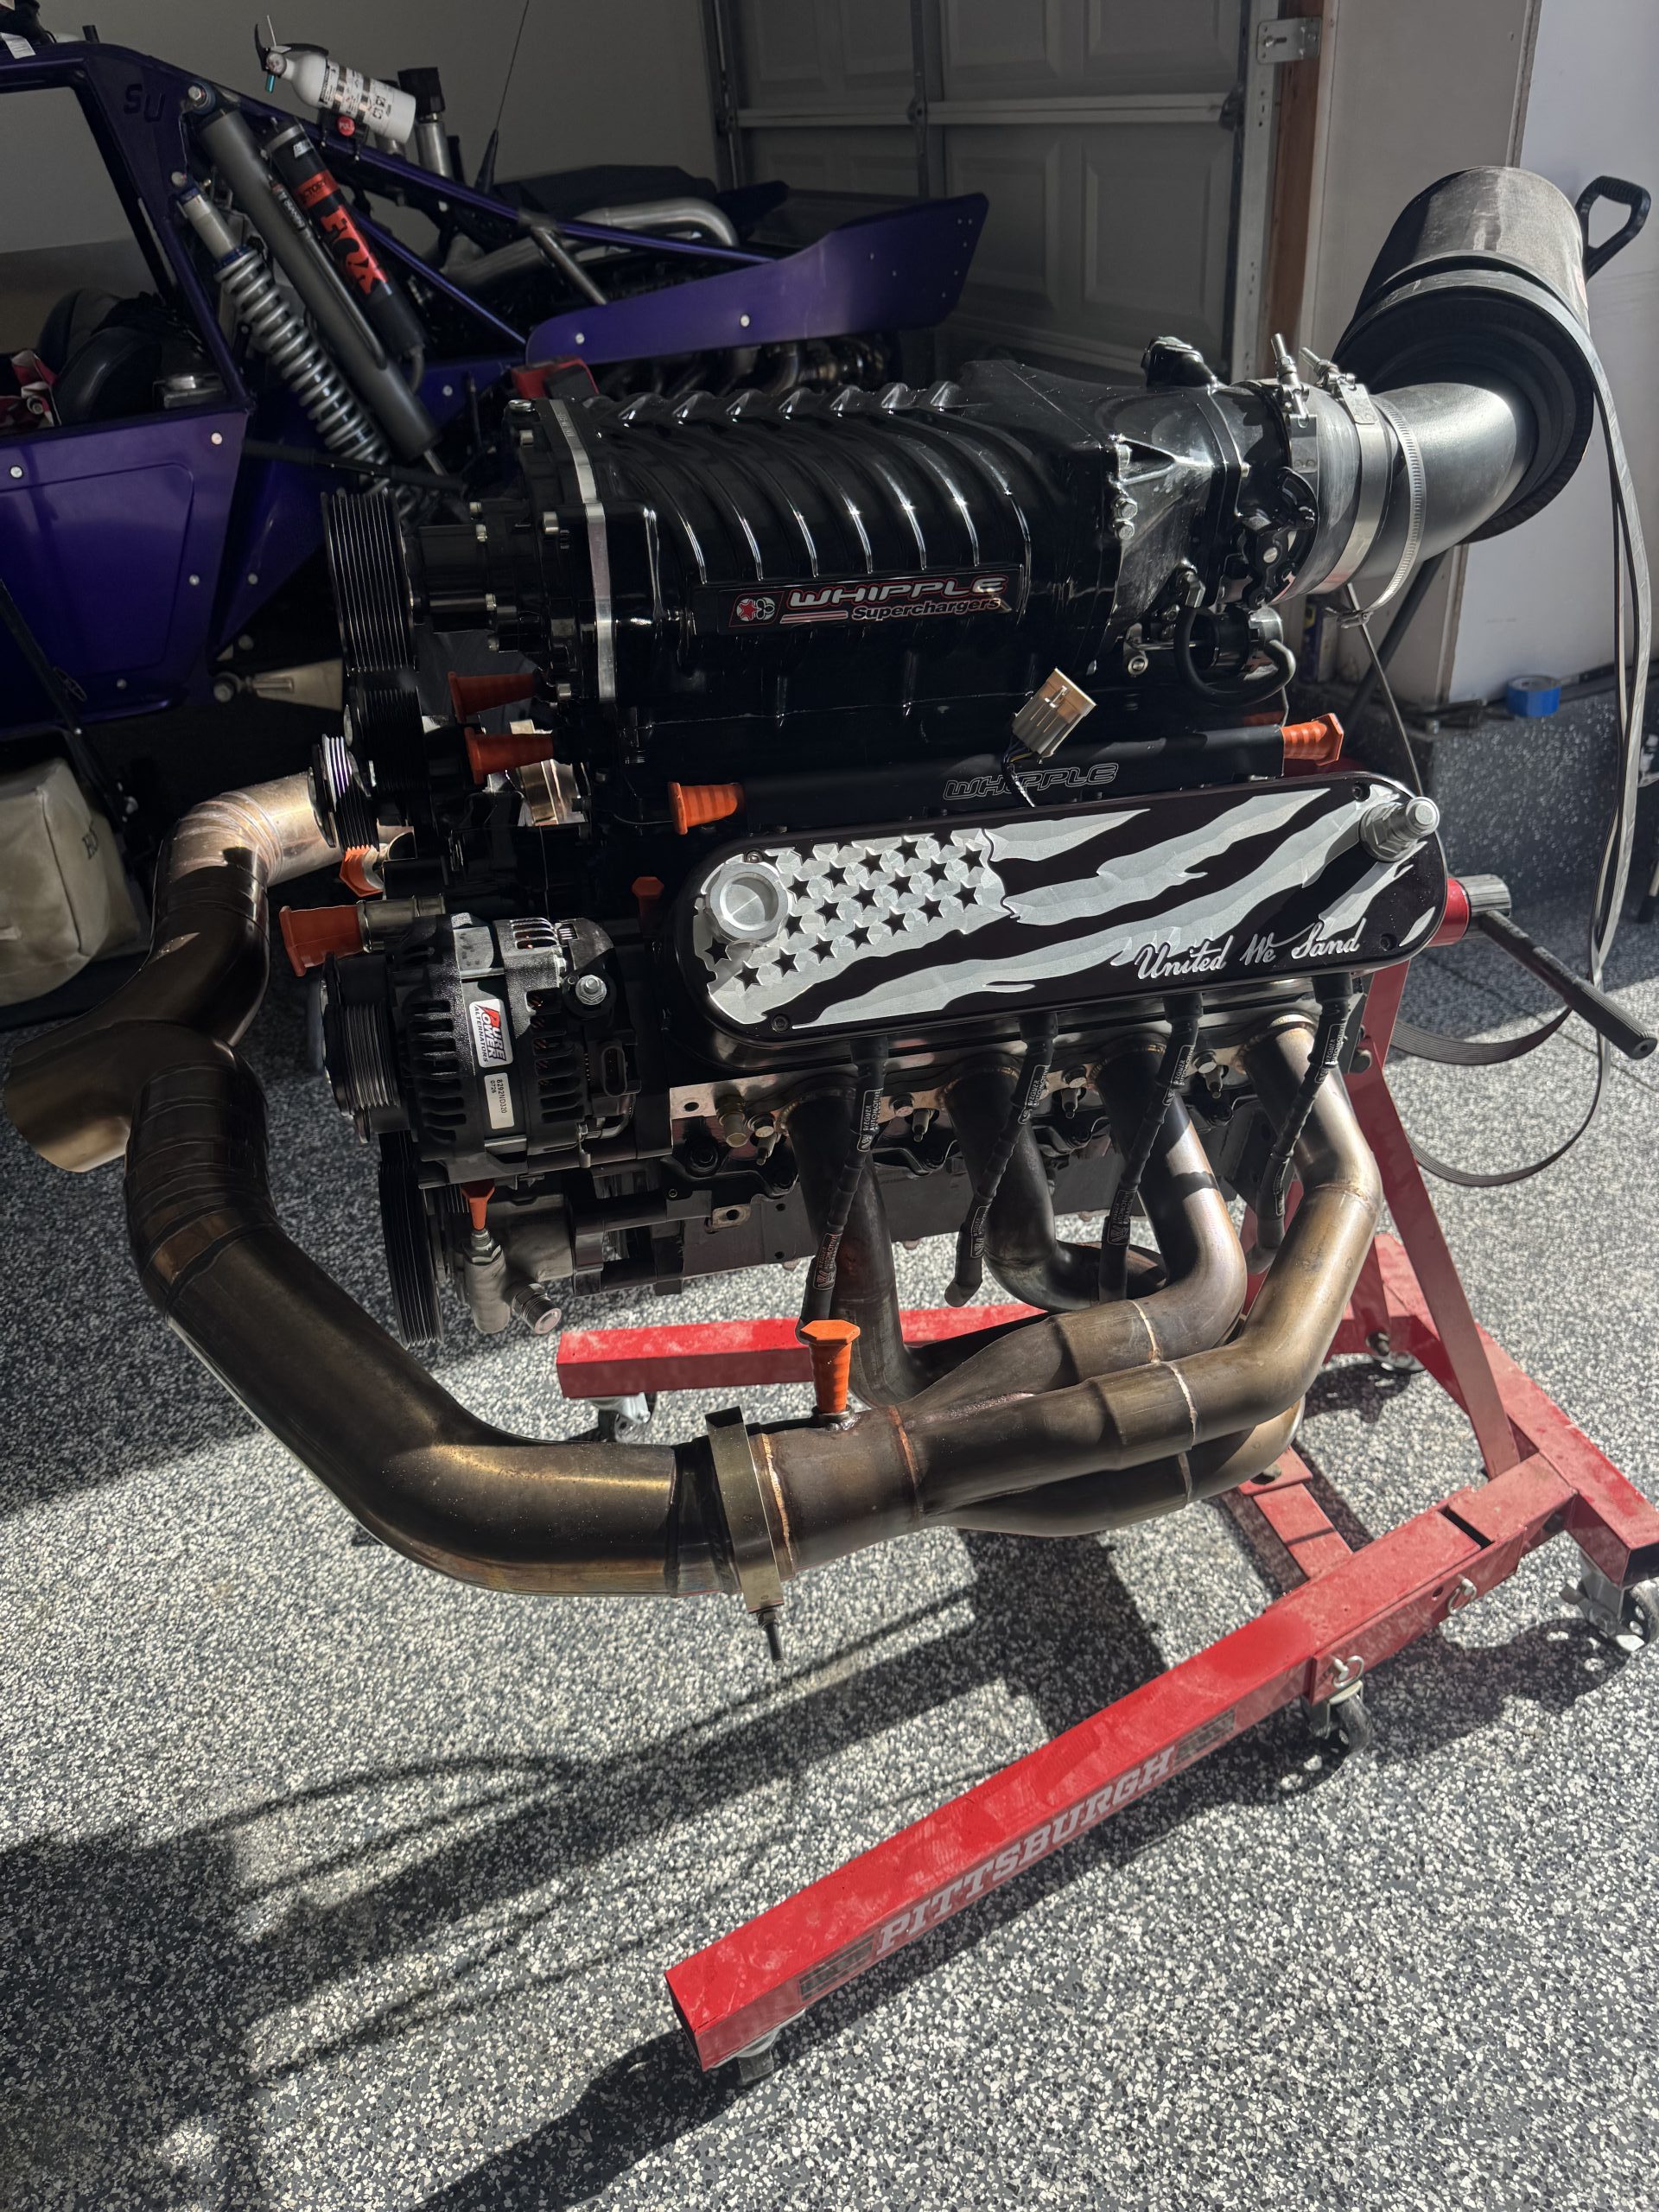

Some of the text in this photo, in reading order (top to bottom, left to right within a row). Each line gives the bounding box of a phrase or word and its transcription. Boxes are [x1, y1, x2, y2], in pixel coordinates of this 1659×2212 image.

[321, 204, 388, 295] FOX
[789, 575, 1009, 608] WHIPPLE
[851, 596, 1002, 621] Superchargers
[943, 762, 1119, 801] WHPPLE
[1134, 934, 1234, 980] United
[1239, 924, 1306, 966] We
[474, 1006, 488, 1063] ALTERNATORS
[875, 1745, 1176, 1956] PITTSBURGH
